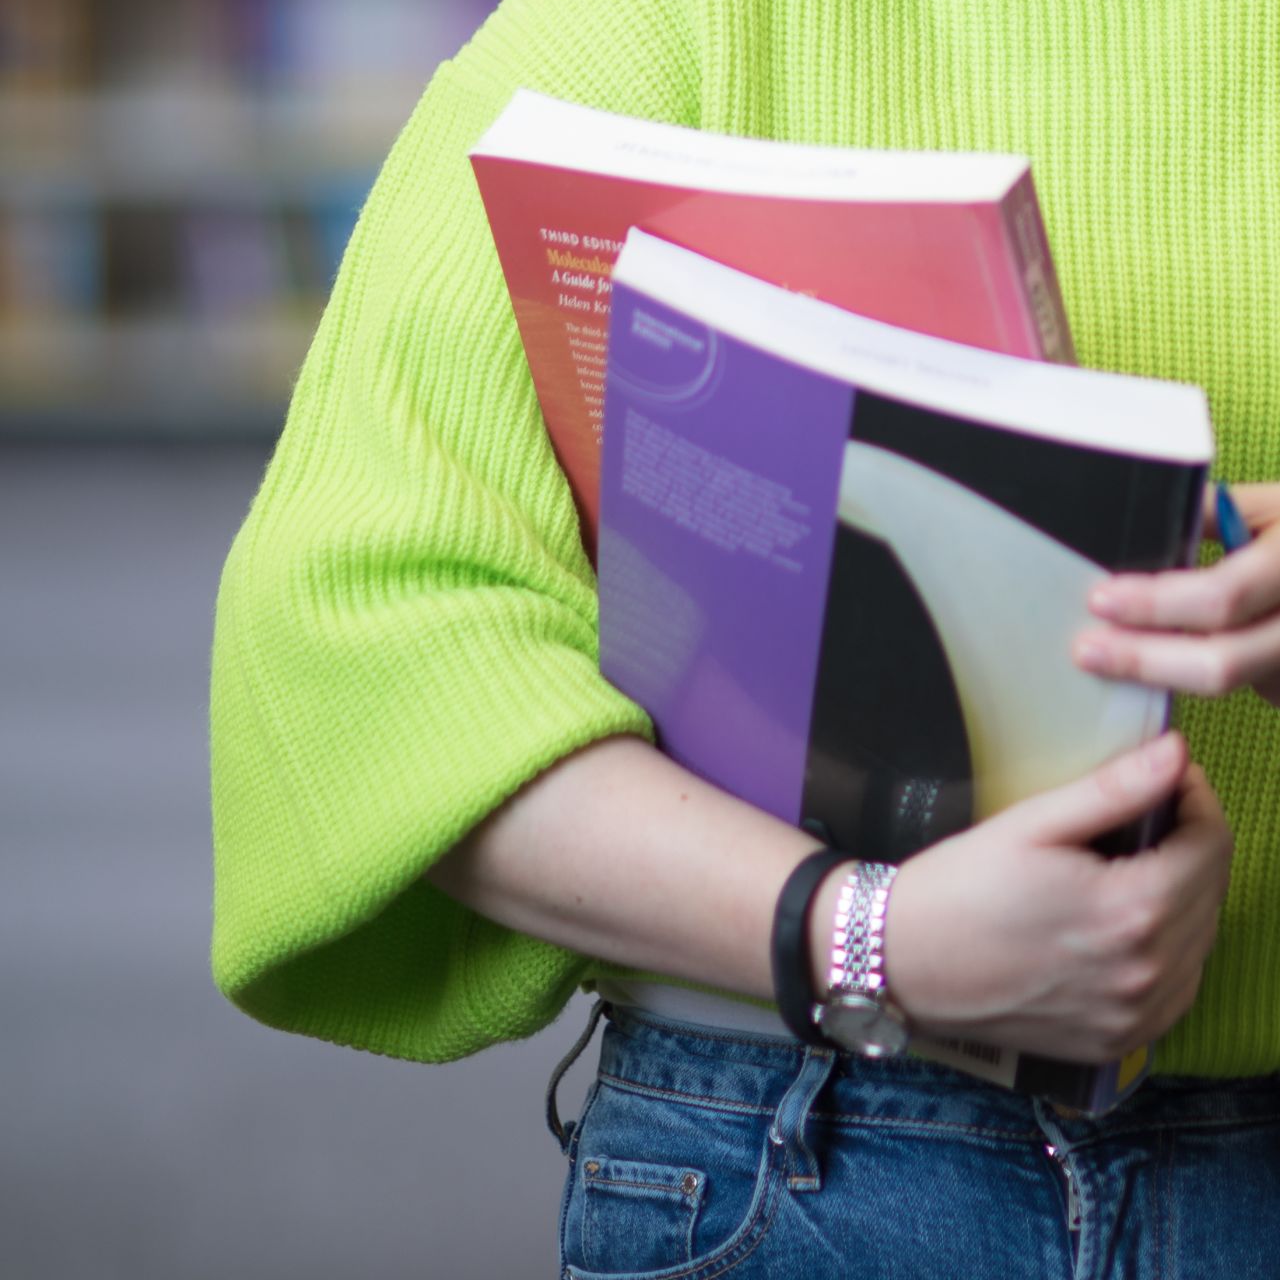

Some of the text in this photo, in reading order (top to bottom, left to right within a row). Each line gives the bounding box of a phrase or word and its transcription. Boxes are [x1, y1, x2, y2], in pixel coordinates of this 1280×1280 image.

[540, 227, 624, 253] THIRD EDITIO
[551, 269, 560, 284] A
[561, 271, 596, 290] Guide
[559, 293, 591, 312] Helen
